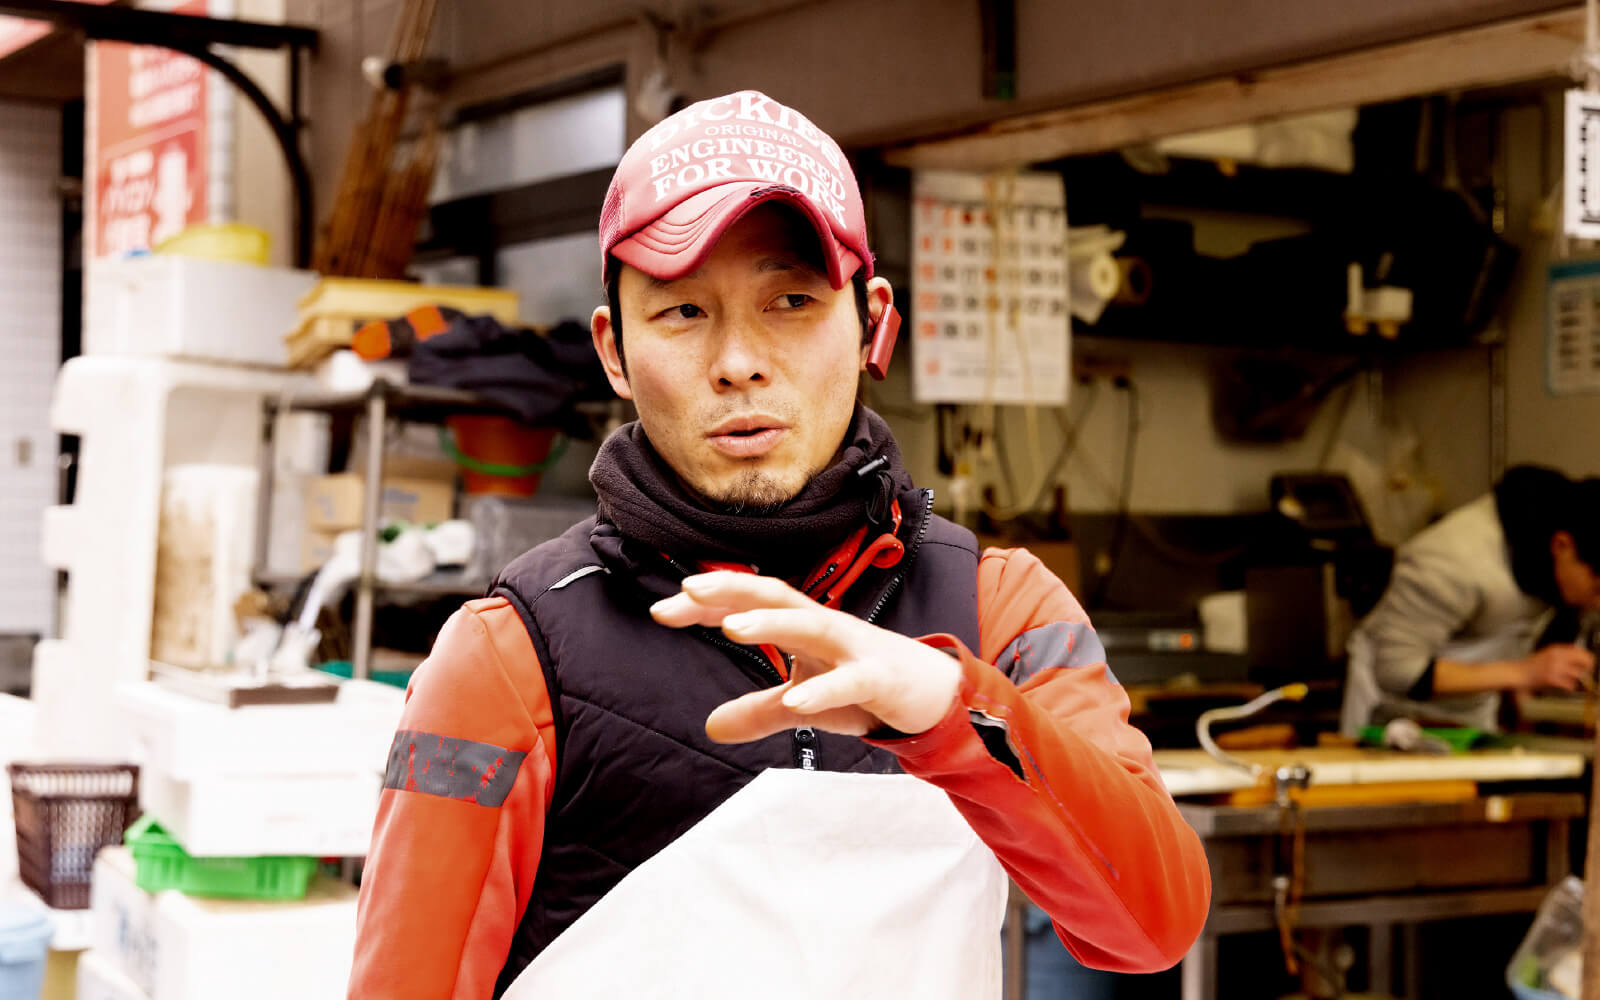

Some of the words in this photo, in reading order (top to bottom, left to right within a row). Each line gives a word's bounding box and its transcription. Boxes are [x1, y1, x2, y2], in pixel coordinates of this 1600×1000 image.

[705, 124, 804, 149] ORIGINAL
[650, 138, 846, 200] ENGINEERED
[653, 157, 736, 202] FOR
[747, 158, 847, 229] WORK
